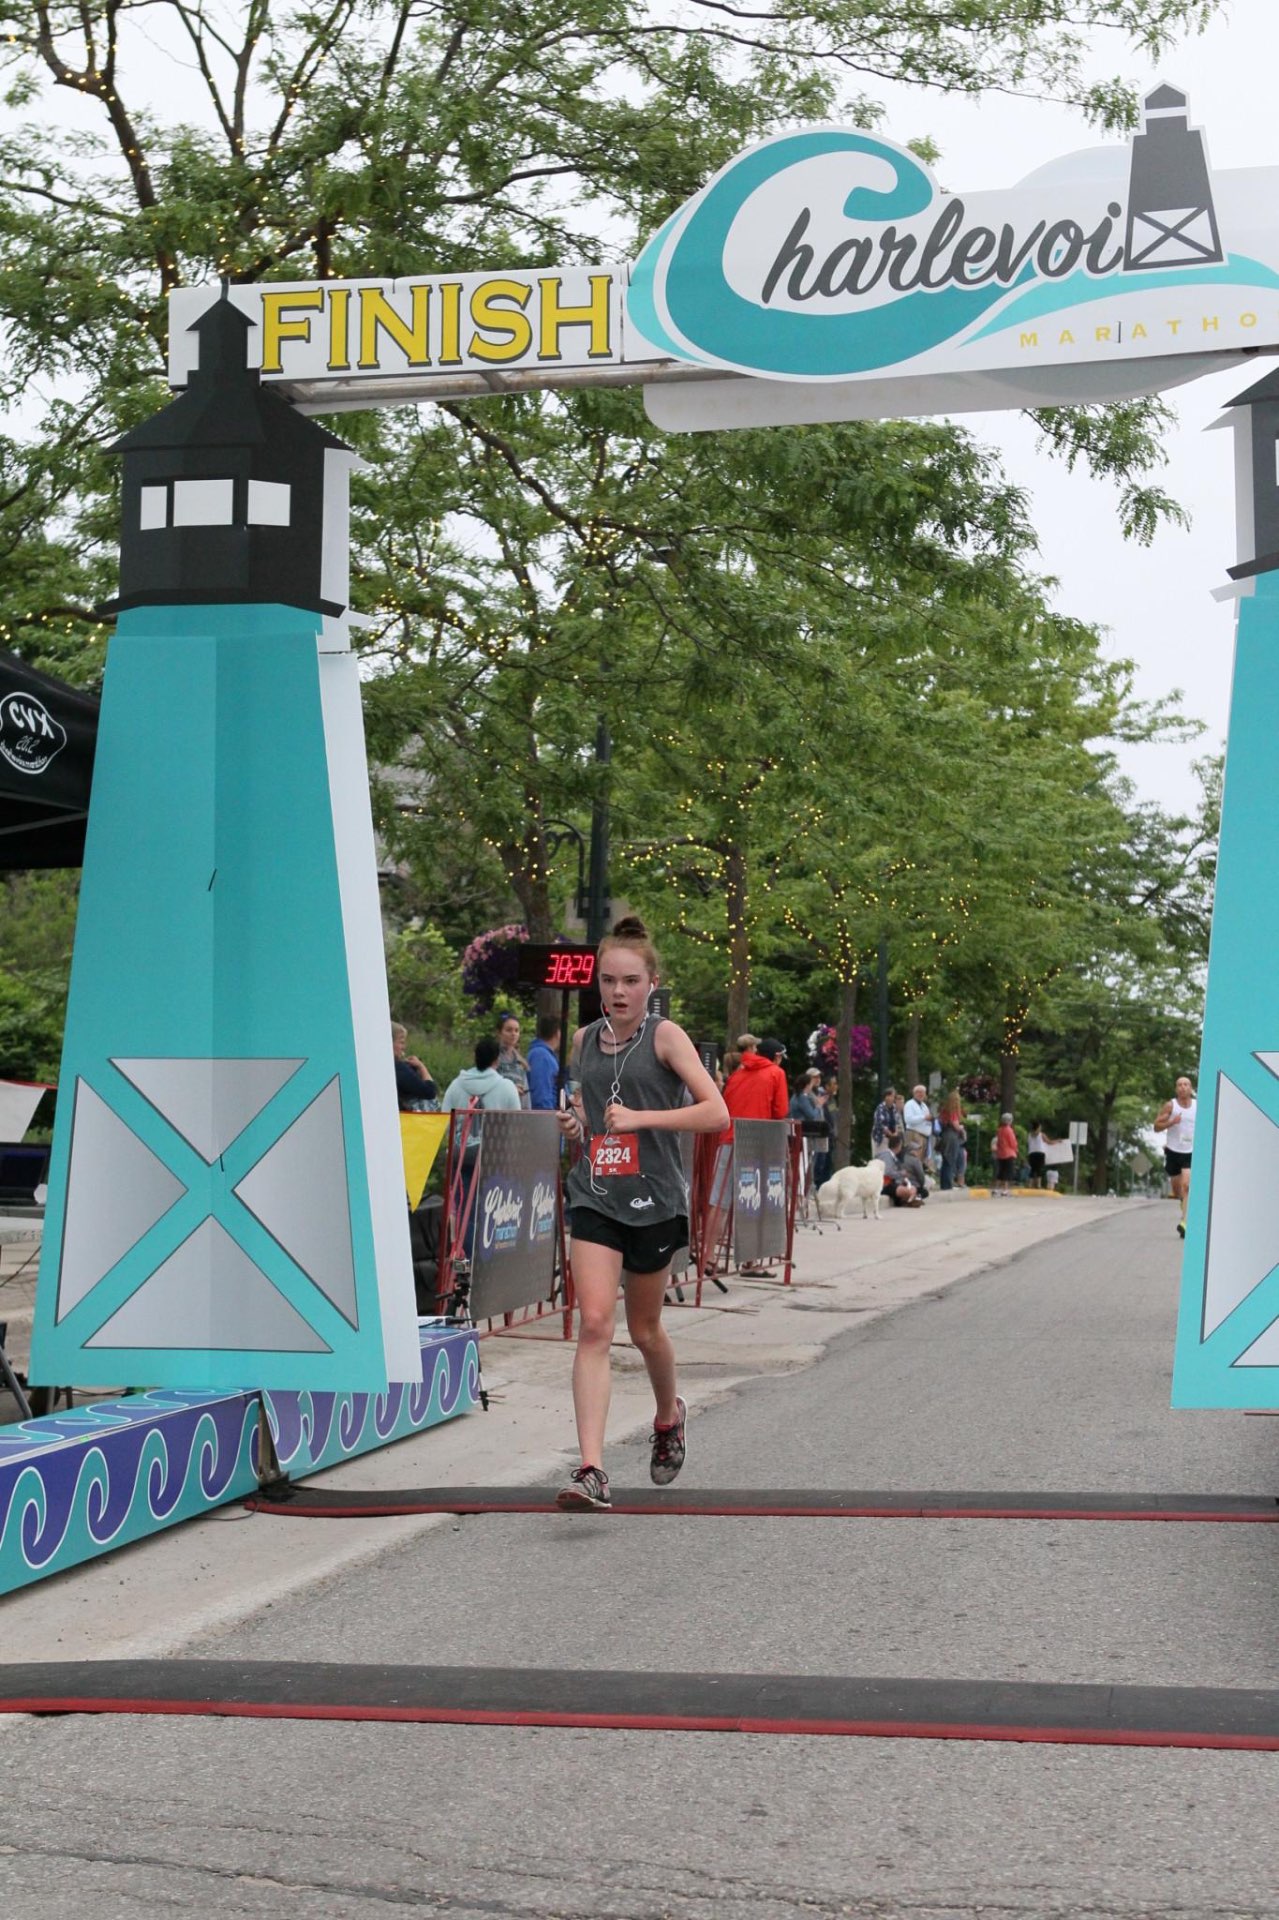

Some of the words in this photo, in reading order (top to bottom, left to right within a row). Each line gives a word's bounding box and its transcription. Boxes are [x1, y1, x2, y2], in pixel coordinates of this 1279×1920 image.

[260, 274, 613, 374] FINISH
[1019, 313, 1279, 347] MARATHO
[9, 701, 55, 739] CVX
[596, 1147, 631, 1165] 2324
